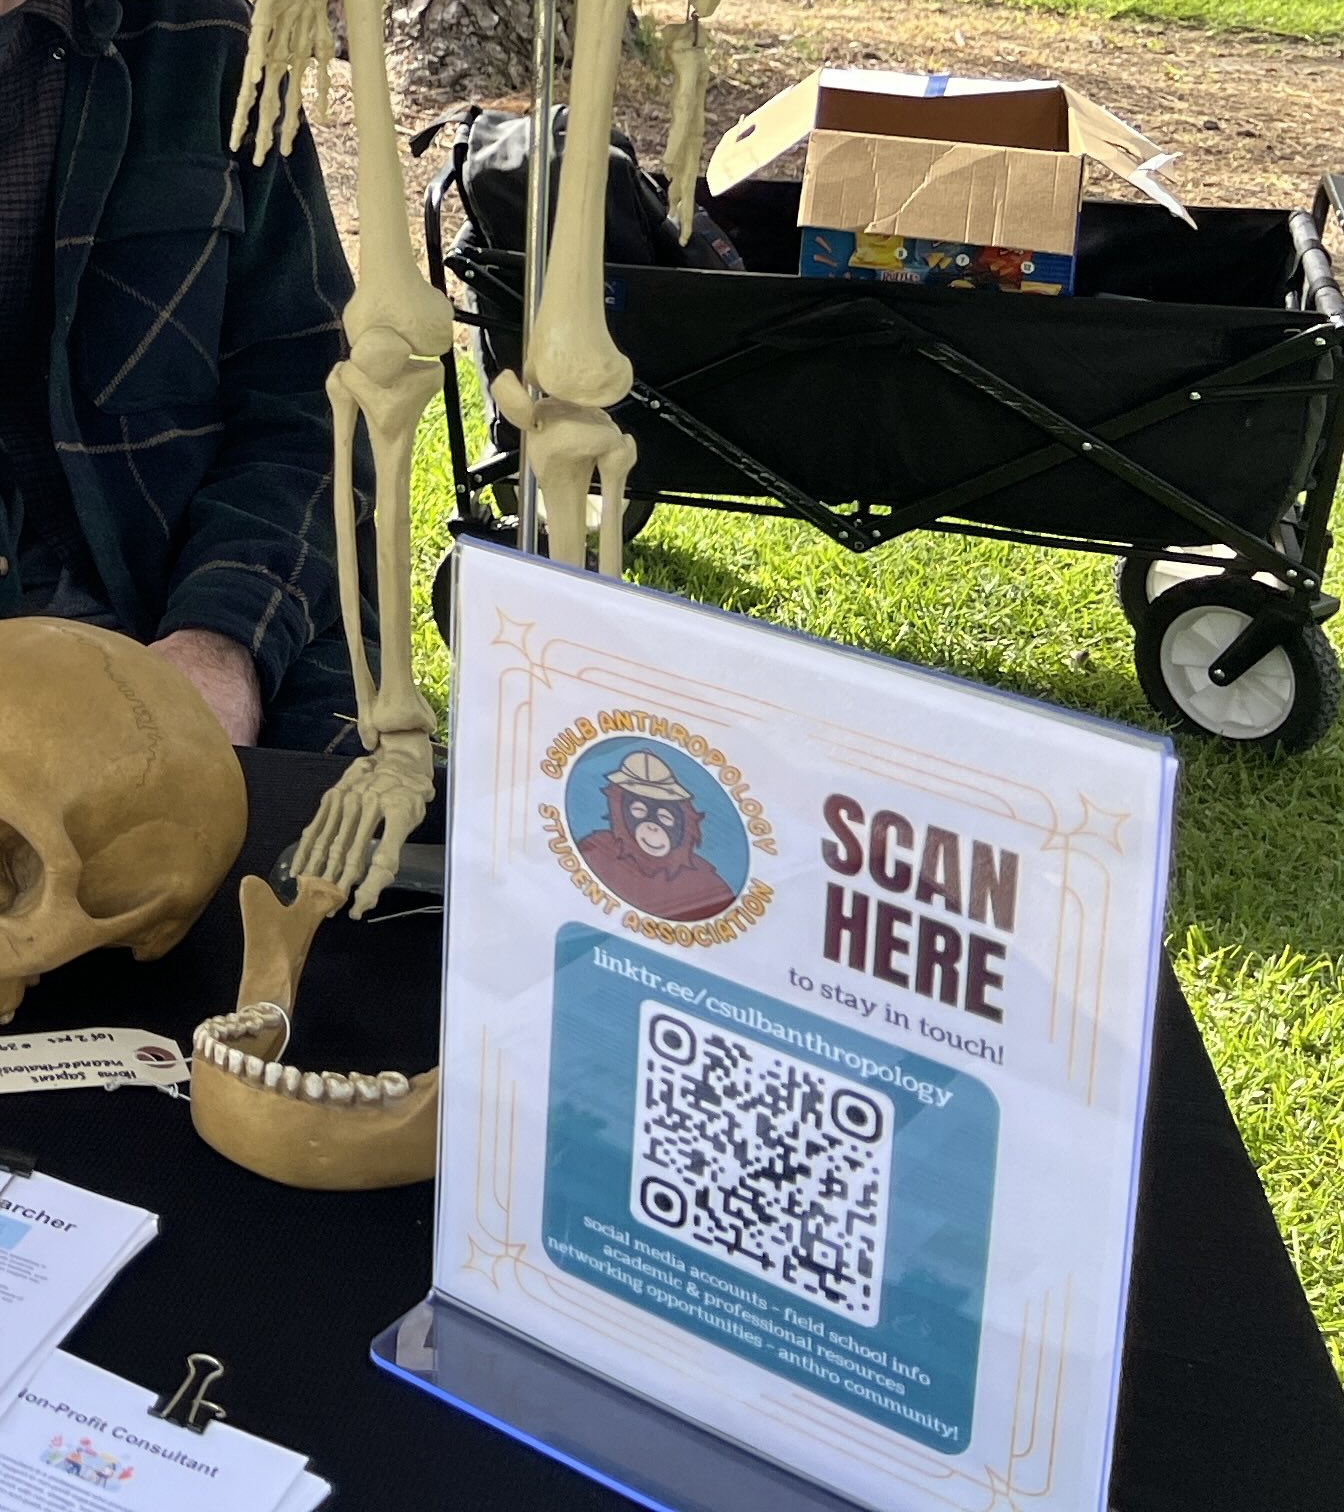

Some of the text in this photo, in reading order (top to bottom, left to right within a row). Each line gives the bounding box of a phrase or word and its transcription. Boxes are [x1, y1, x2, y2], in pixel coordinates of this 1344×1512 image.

[540, 708, 779, 857] CSULB ANTHROPOLOGY
[538, 802, 776, 949] STUDENT ASSOCIATION
[822, 794, 1019, 933] SCAN
[593, 945, 955, 1108] linktr.ee/csulbanthropology
[789, 967, 1003, 1065] to stay in touch!
[823, 882, 1007, 1024] HERE
[544, 1236, 958, 1440] networking opportunities anthro community!
[583, 1215, 930, 1385] social media accounts field school info
[602, 1244, 905, 1395] academic & professional resources
[111, 1426, 218, 1478] Consultant
